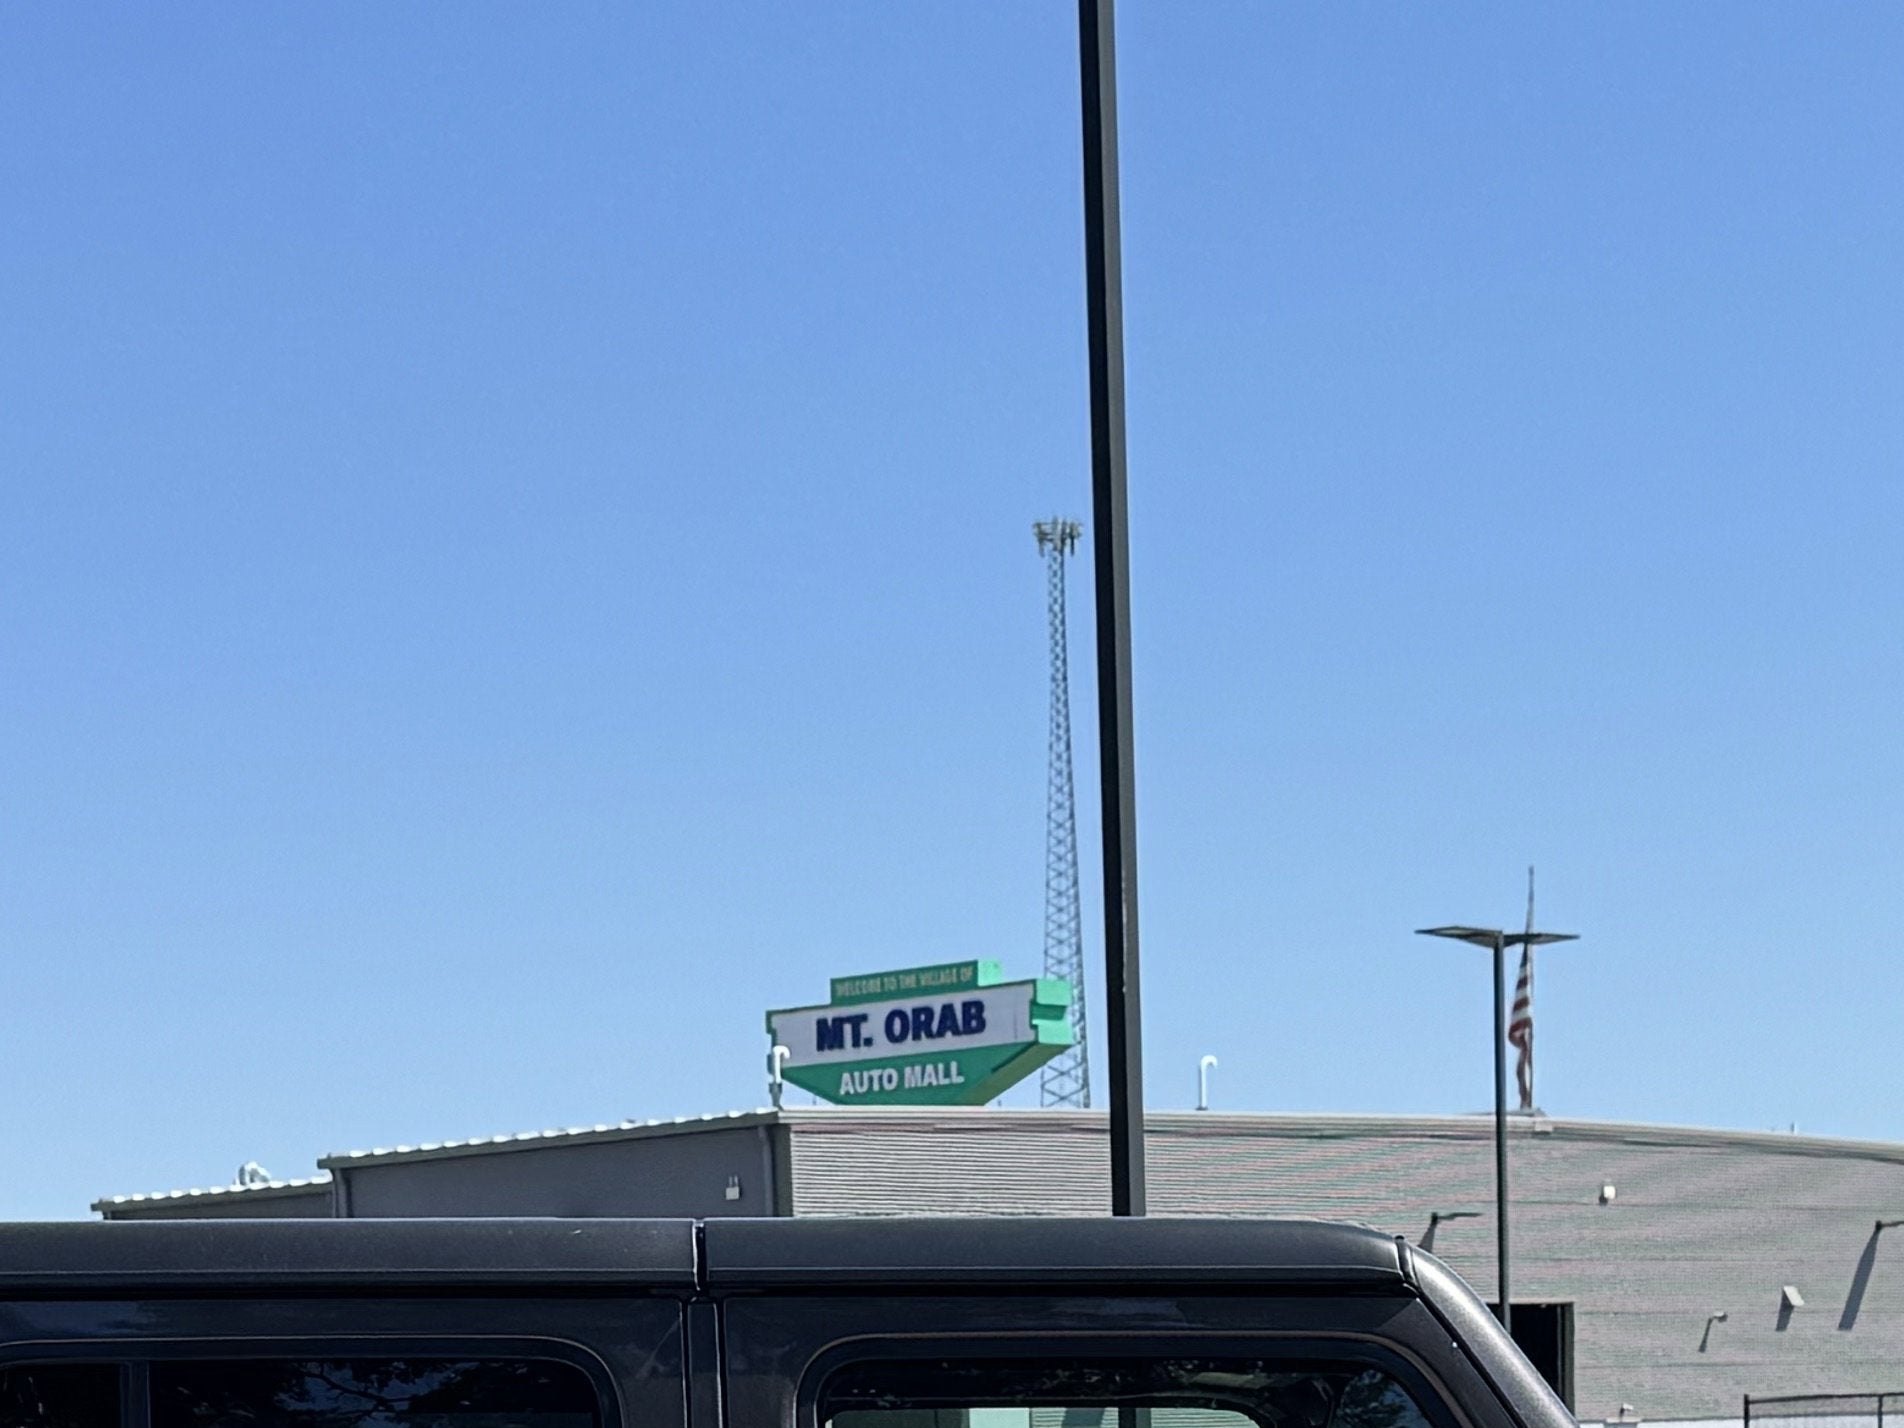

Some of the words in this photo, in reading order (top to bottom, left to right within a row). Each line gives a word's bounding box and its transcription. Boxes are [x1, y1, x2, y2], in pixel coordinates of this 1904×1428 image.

[816, 1013, 873, 1052] MT.
[884, 1000, 986, 1044] ORAB
[840, 1067, 898, 1096] AUTO
[904, 1061, 965, 1089] MALL
